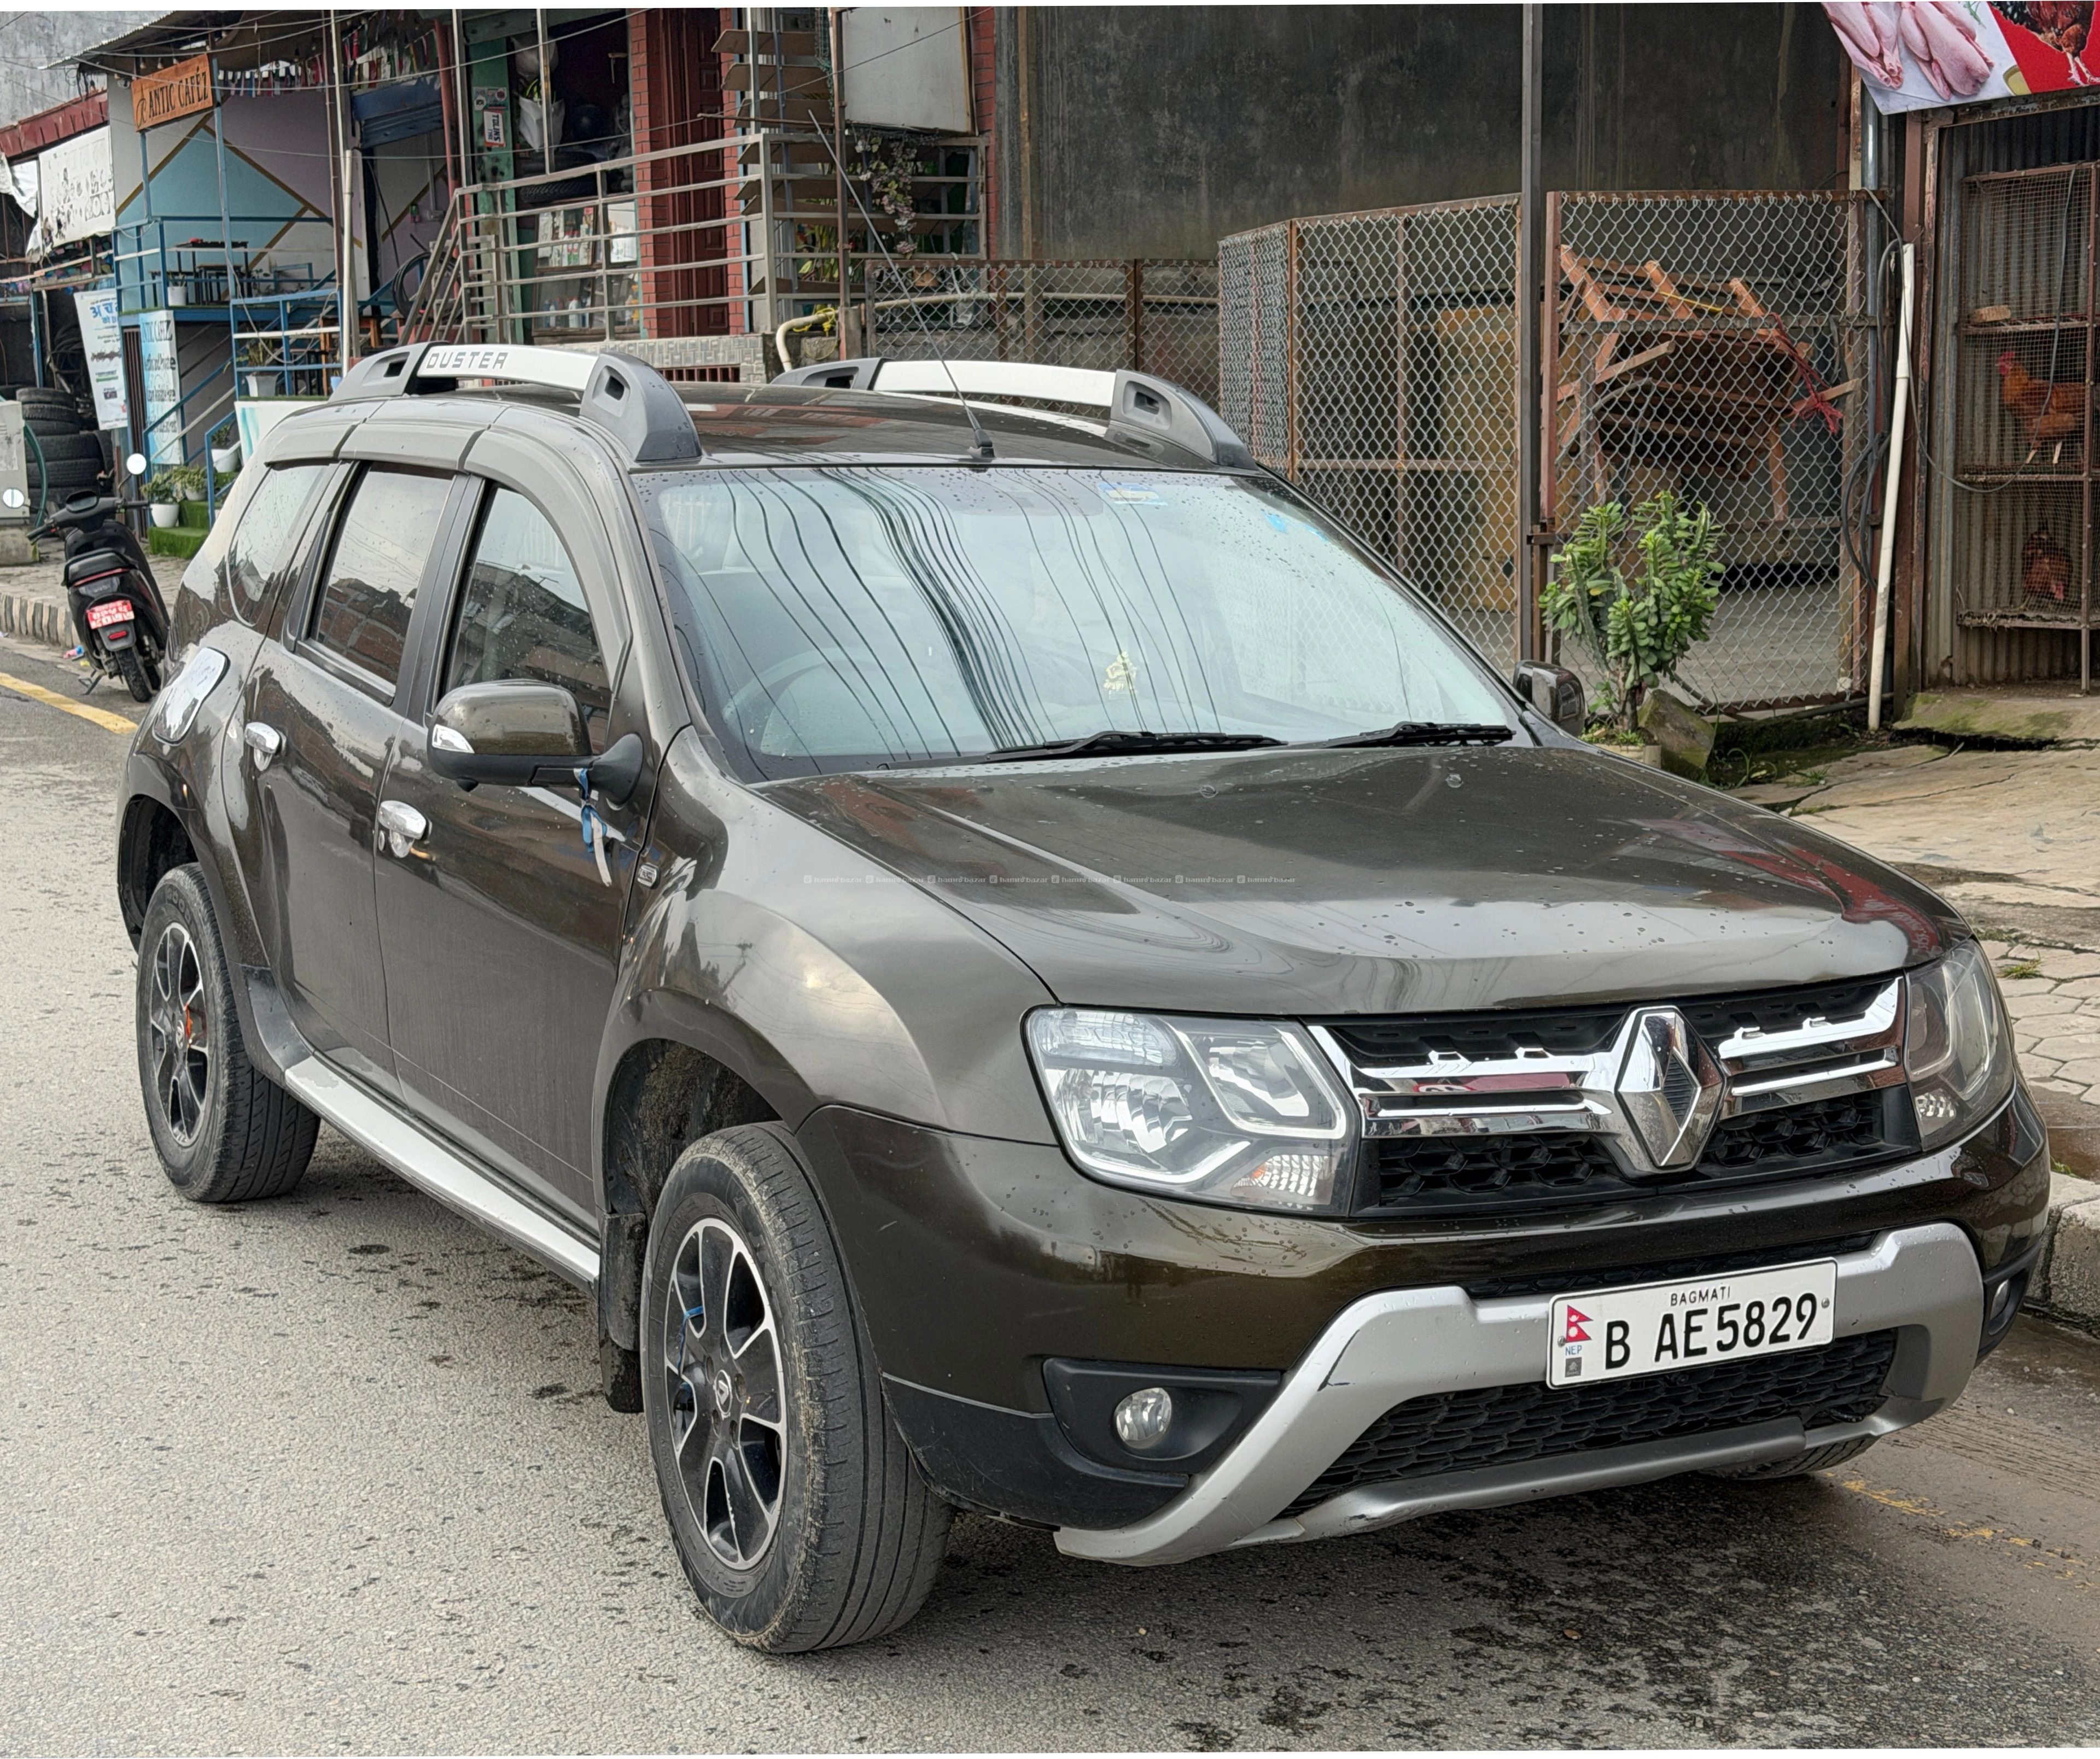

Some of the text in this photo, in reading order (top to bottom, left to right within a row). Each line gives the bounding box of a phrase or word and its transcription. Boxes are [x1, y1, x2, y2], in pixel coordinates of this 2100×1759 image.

[149, 83, 176, 119] ANTIC
[426, 351, 509, 369] DUSTER
[1671, 1286, 1730, 1307] BAGMATI
[1565, 1345, 1582, 1356] NEP
[1605, 1320, 1630, 1370] B
